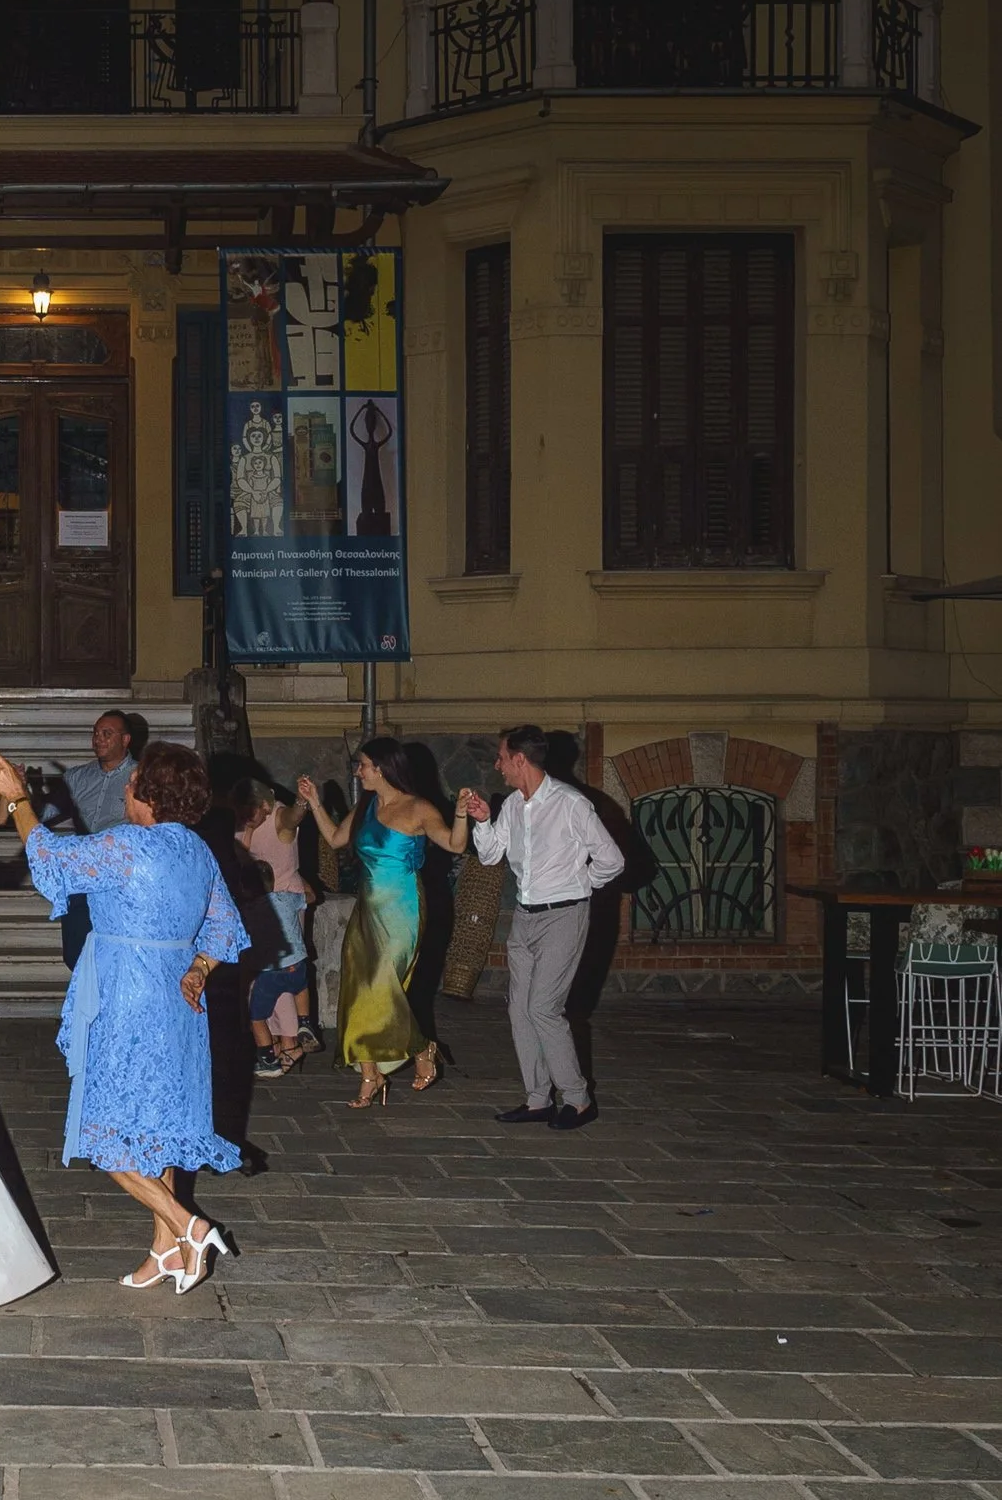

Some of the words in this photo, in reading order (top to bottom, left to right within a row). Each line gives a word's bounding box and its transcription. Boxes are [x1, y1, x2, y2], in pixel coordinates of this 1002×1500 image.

[231, 550, 275, 561] Δημοτική
[277, 549, 333, 561] Πινακοθήκη
[335, 549, 401, 561] Θεσσαλονίκης
[232, 568, 277, 579] Municipal
[279, 569, 294, 577] Art
[297, 567, 329, 579] Gallery
[331, 567, 343, 577] Of
[345, 567, 400, 577] Thessaloniki
